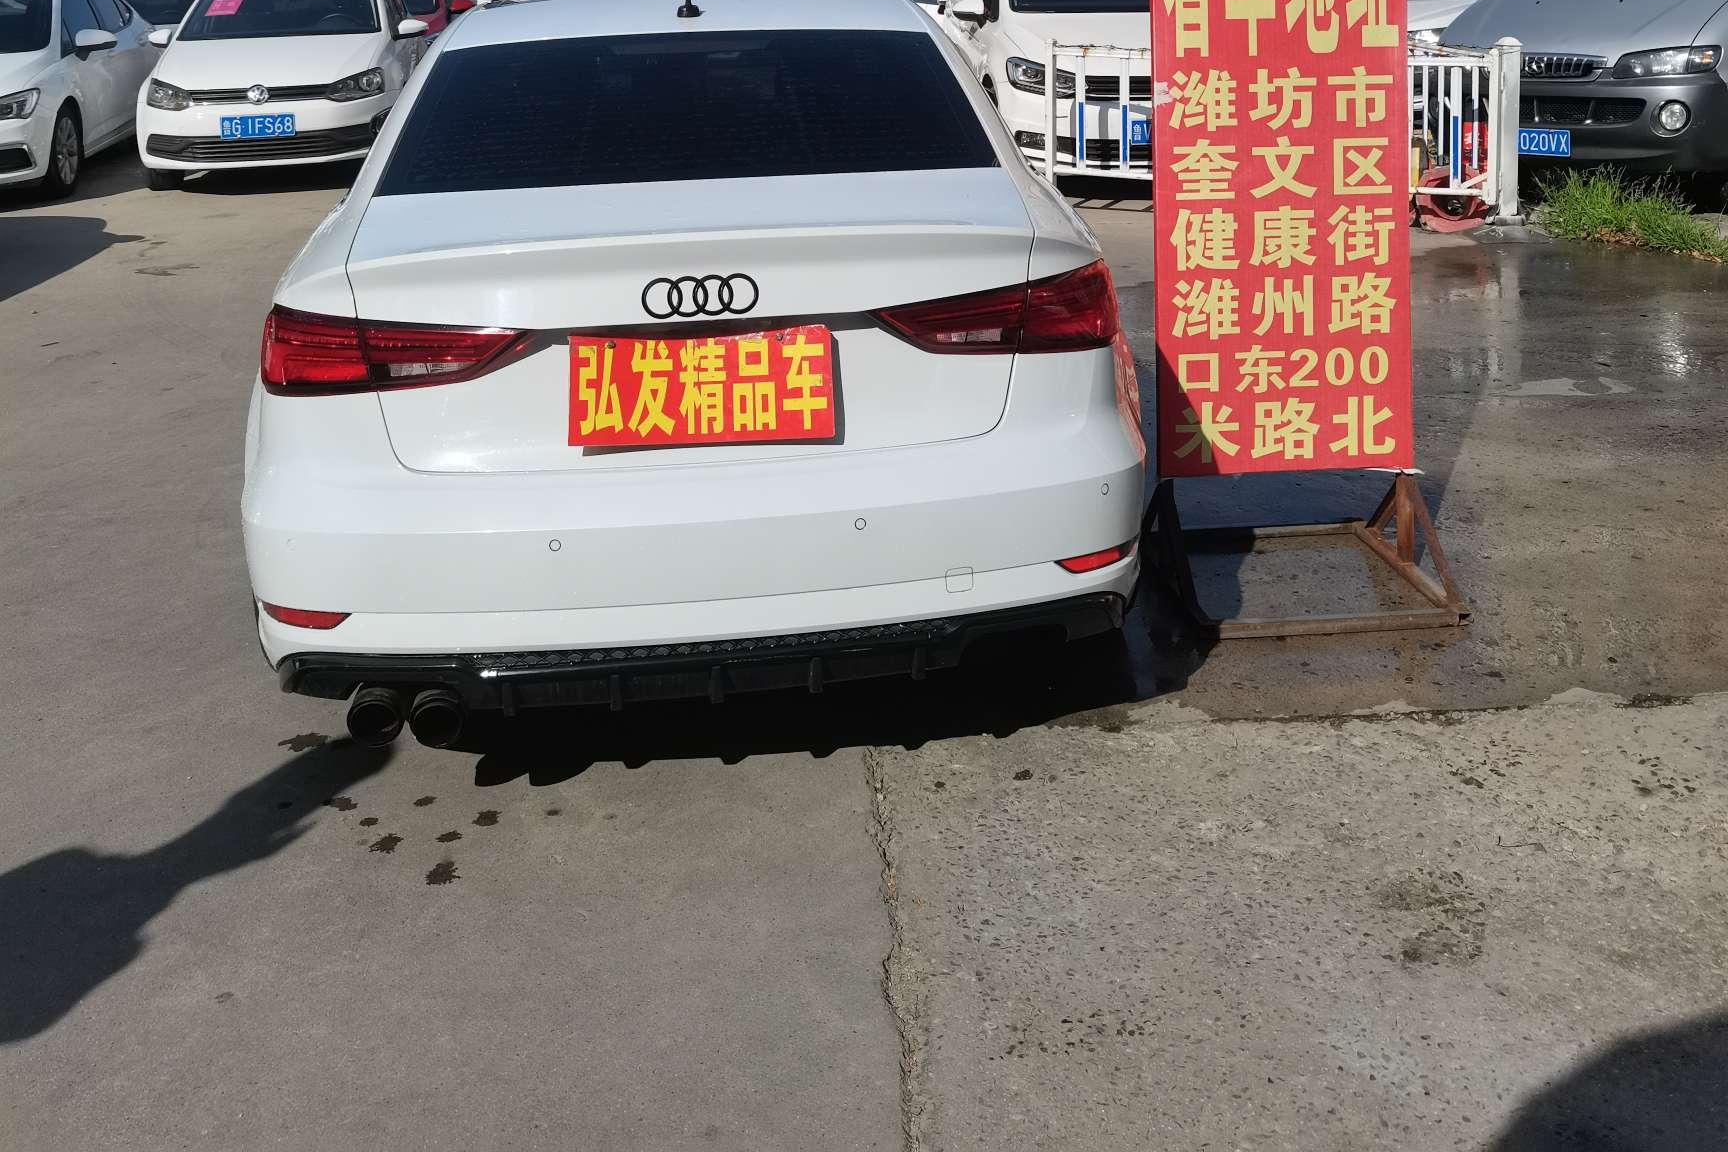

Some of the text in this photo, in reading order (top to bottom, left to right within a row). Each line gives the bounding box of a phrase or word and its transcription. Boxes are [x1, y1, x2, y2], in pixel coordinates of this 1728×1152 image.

[1169, 66, 1393, 131] 潍坊市
[1170, 137, 1393, 201] 奎文区
[1520, 132, 1568, 153] 020VX
[1170, 205, 1396, 271] 健康街
[1172, 272, 1396, 339] 潍州路
[578, 334, 828, 437] 弘发精品车
[1177, 345, 1389, 394] 口东200
[1174, 395, 1396, 463] 米路北
